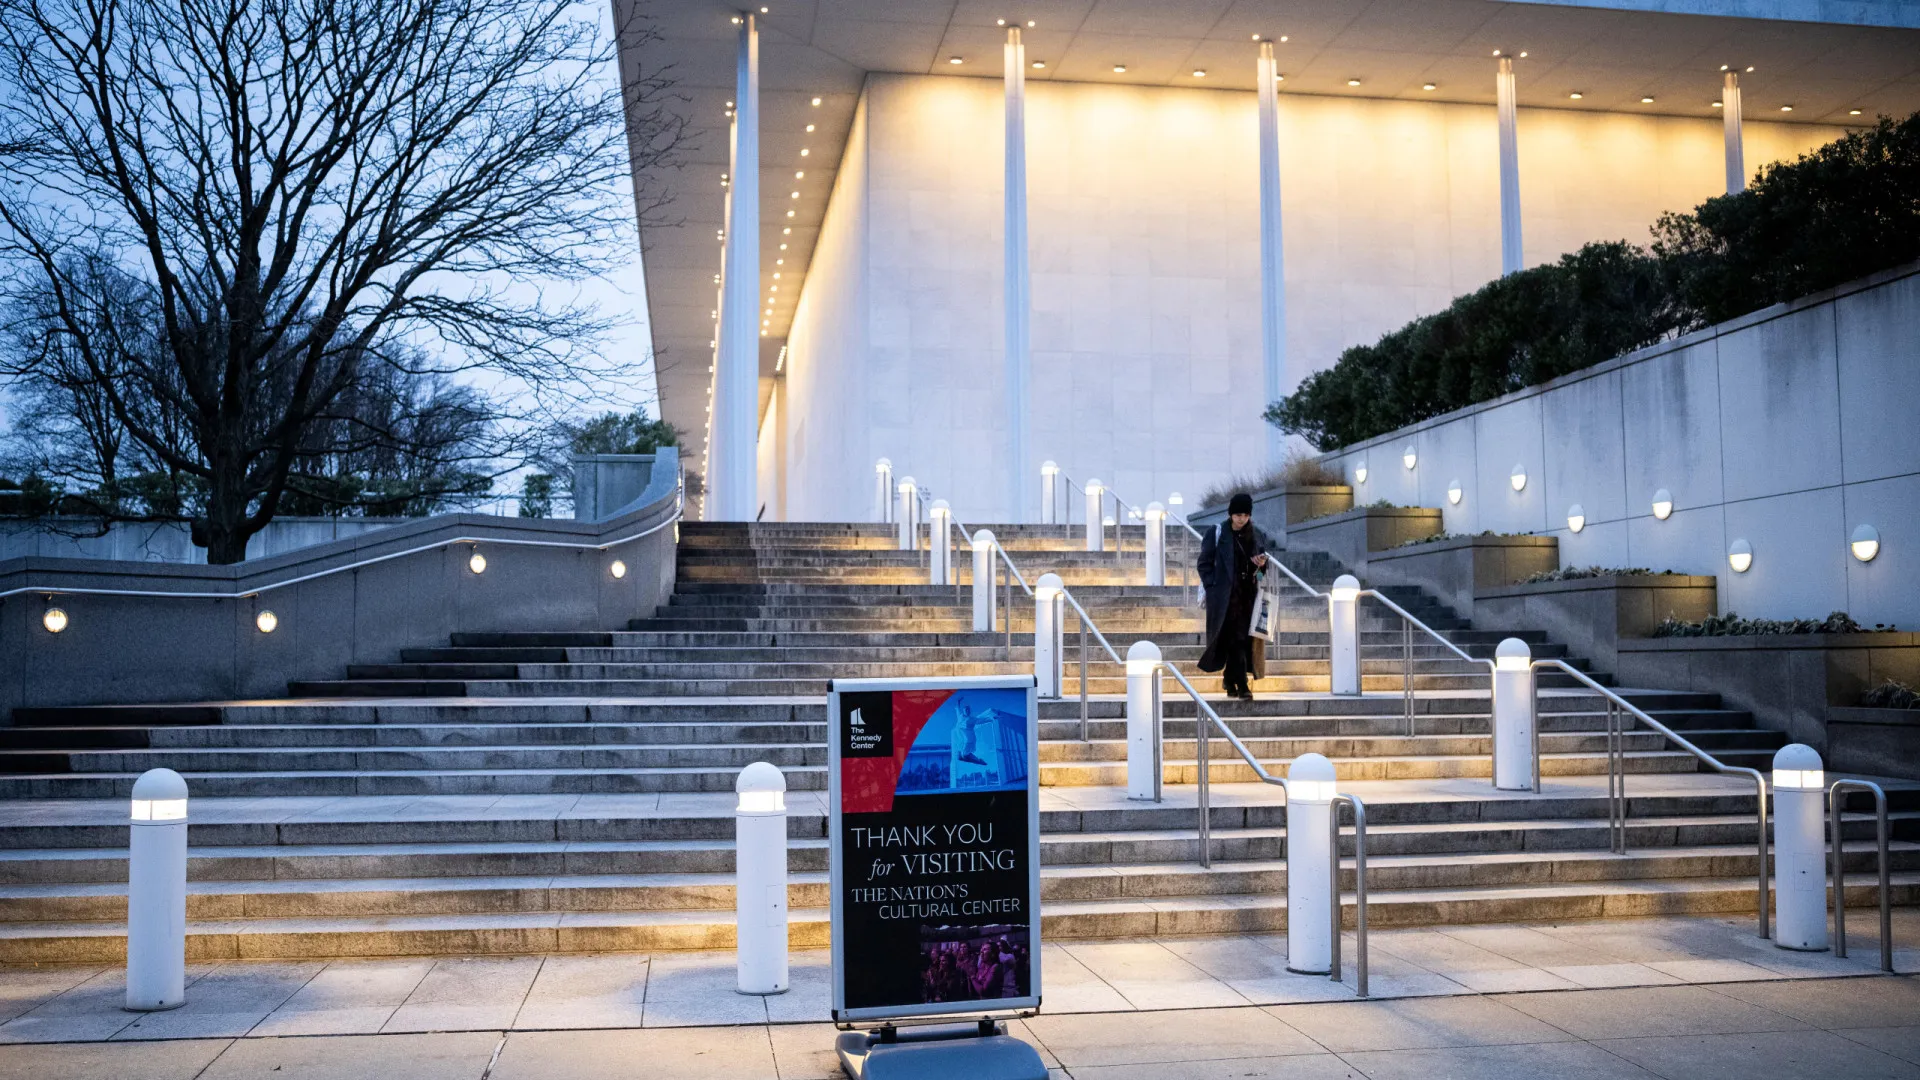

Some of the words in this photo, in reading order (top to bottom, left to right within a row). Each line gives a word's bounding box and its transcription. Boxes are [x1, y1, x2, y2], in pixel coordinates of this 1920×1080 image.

[851, 734, 882, 742] Kennedy
[851, 825, 936, 848] THANK
[943, 822, 993, 844] YOU
[867, 859, 895, 881] for
[900, 849, 1016, 874] VISITING
[851, 887, 886, 902] THE
[879, 903, 959, 919] CULTURAL
[962, 898, 1020, 915] CENTER
